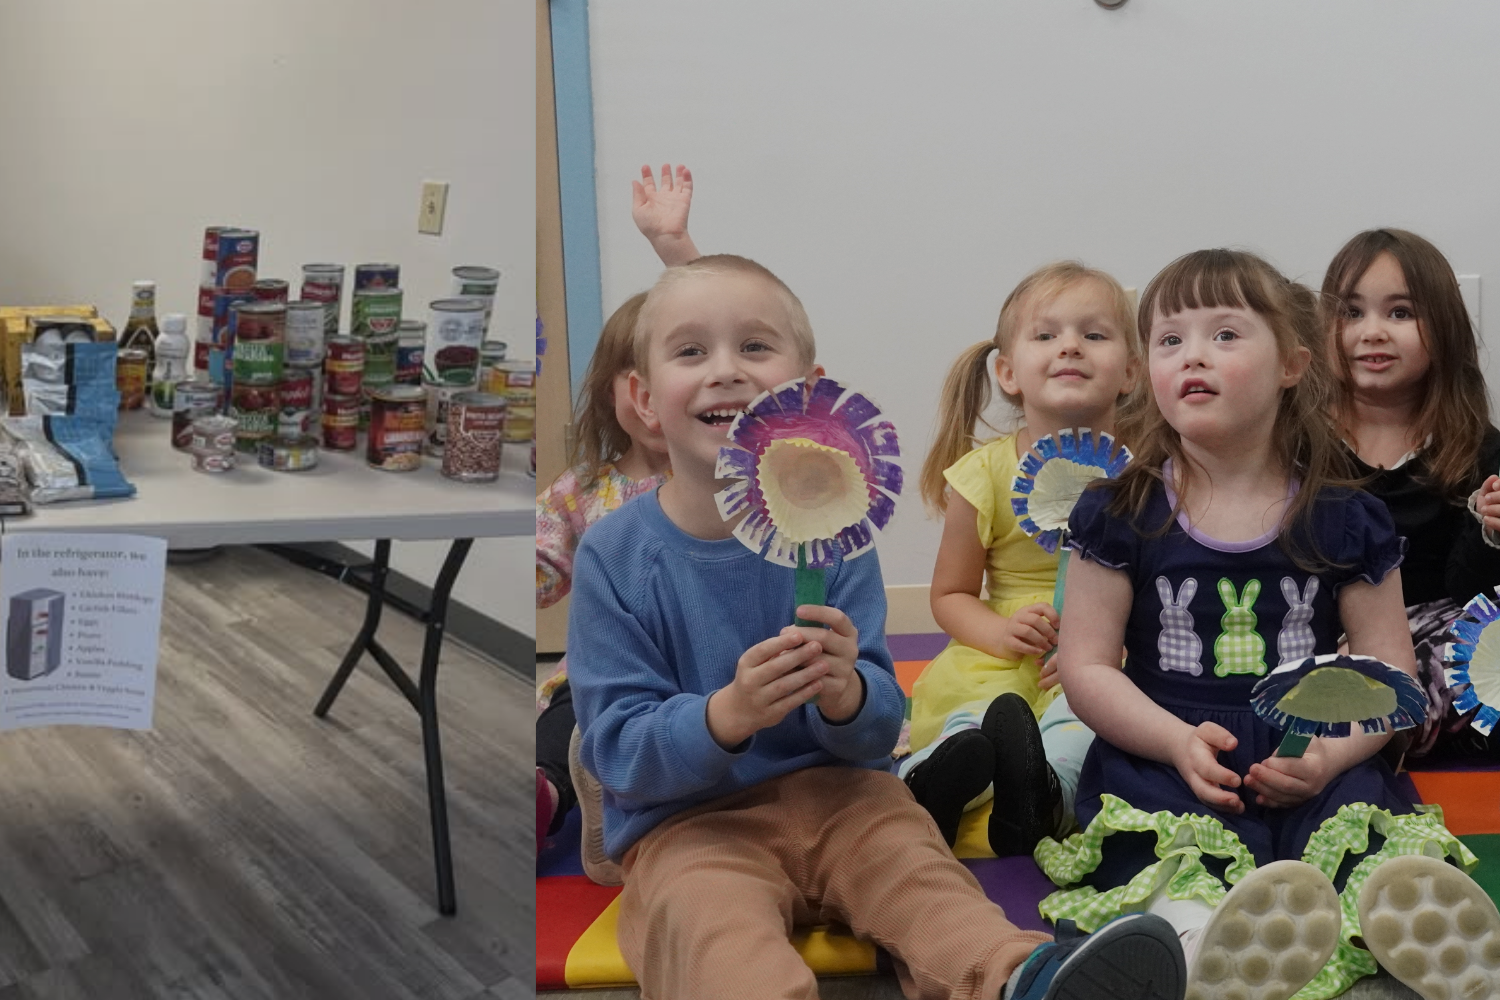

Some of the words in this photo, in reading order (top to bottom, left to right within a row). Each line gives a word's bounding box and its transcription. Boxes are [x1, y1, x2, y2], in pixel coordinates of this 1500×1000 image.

[17, 549, 28, 558] In
[32, 548, 50, 558] the
[54, 548, 127, 560] refrigerator,
[51, 568, 74, 577] also
